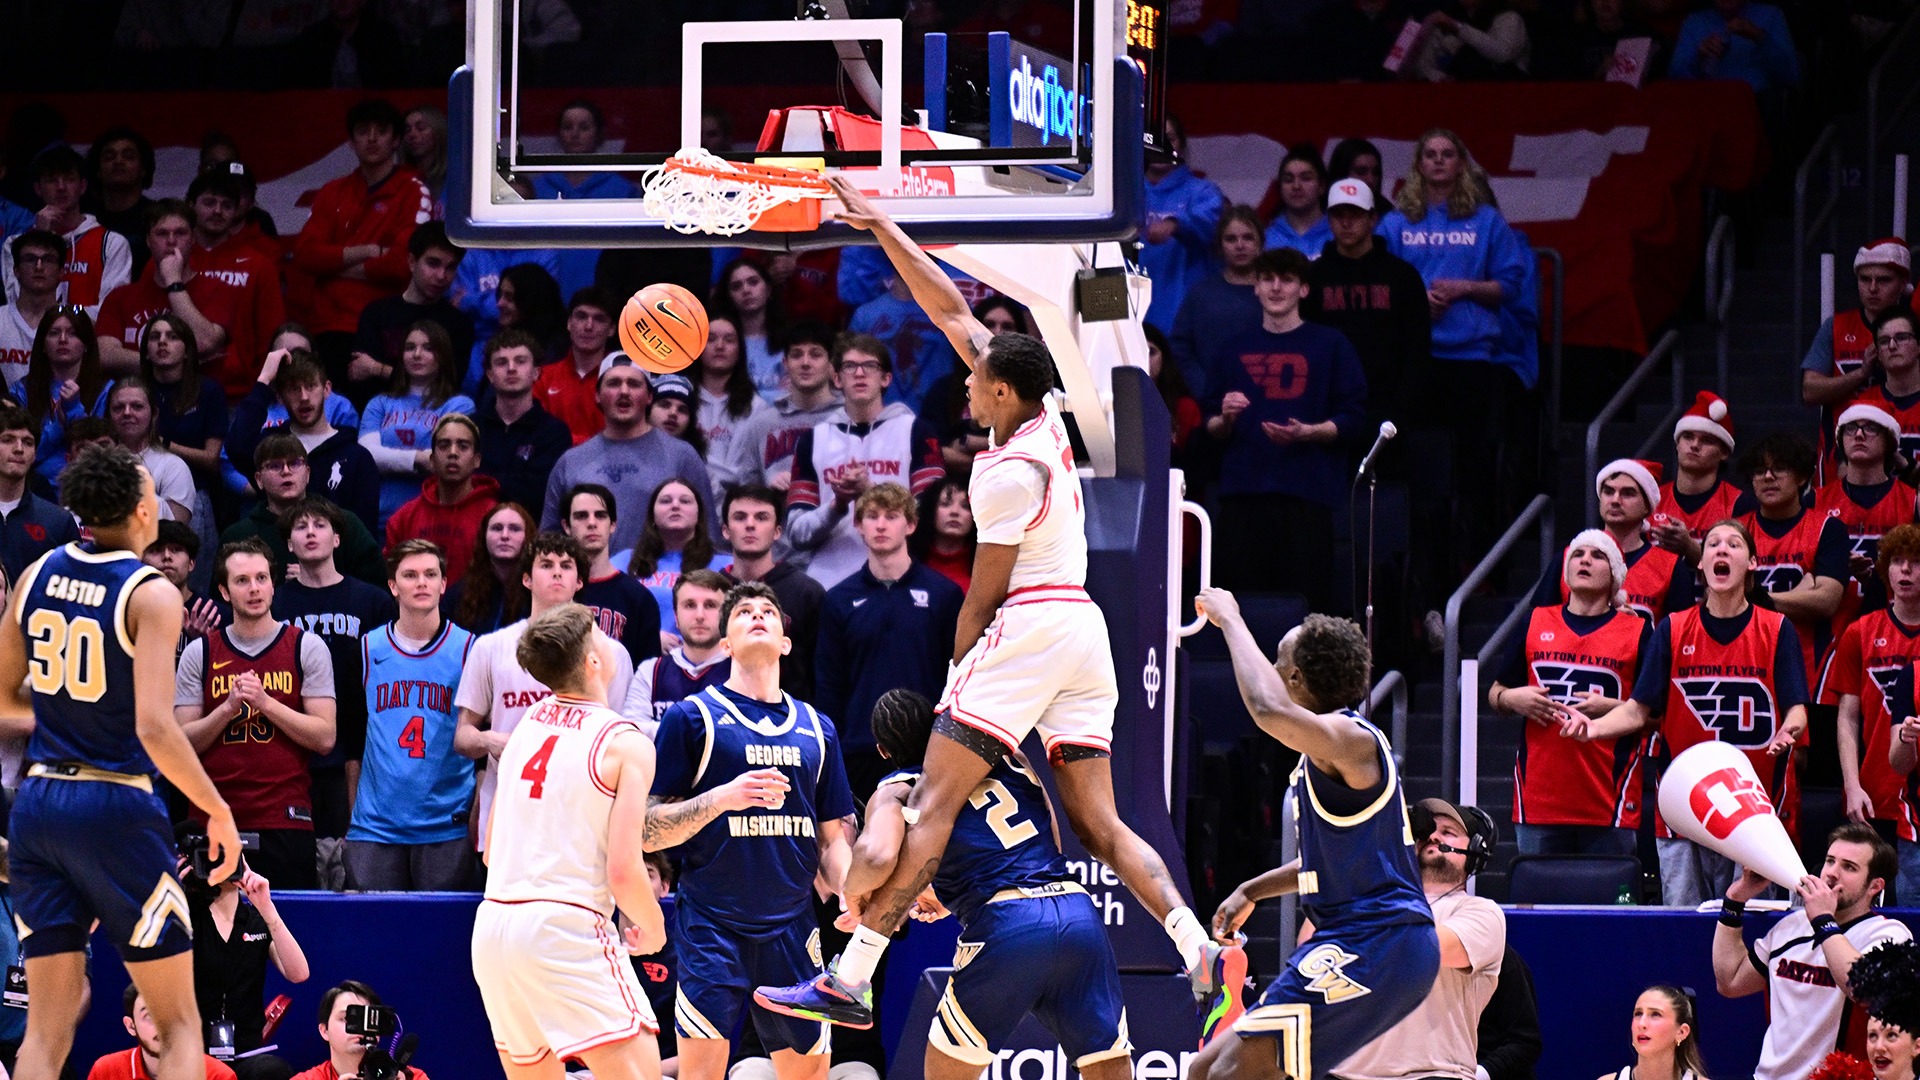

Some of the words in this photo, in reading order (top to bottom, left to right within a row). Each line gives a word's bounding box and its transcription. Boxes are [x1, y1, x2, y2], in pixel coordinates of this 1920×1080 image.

[1010, 54, 1086, 146] altafiber
[1402, 231, 1477, 246] DAYTON
[635, 318, 673, 358] ELITE
[0, 349, 31, 364] DAY
[823, 459, 900, 483] DATON
[45, 573, 107, 608] CASTRO
[1629, 594, 1657, 605] YERS
[284, 613, 361, 640] AYTON
[587, 606, 627, 640] TON
[28, 608, 107, 703] 30
[1533, 651, 1577, 663] DAYTON
[376, 680, 453, 715] DAYTON
[398, 715, 427, 759] 4
[520, 734, 560, 799] 4
[745, 744, 802, 767] GEORGE
[968, 777, 1039, 850] 2
